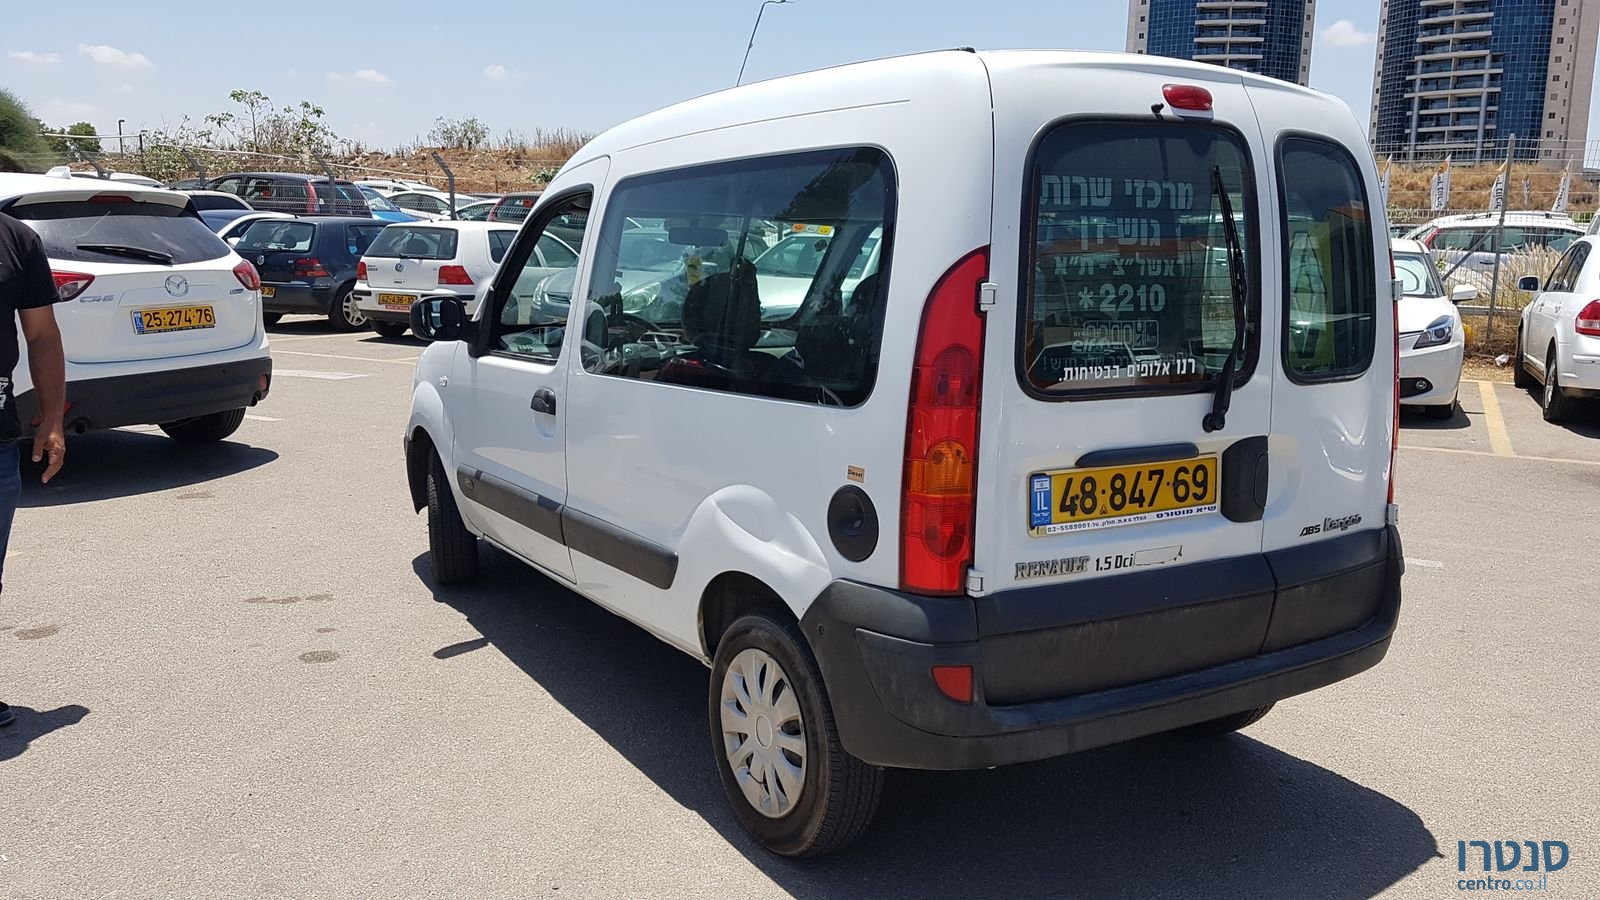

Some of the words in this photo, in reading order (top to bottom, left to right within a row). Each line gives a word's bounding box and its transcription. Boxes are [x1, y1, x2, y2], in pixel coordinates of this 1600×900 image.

[1040, 175, 1112, 207] שרות
[1124, 179, 1193, 209] מרכזי
[1080, 215, 1106, 250] דן
[1117, 217, 1161, 247] גוש
[1059, 365, 1120, 381] בבטיחות.
[1127, 360, 1170, 377] אלופים
[1176, 358, 1196, 375] רנו
[1036, 492, 1048, 510] IL
[1196, 505, 1217, 513] שיא
[1156, 508, 1193, 518] מוטורס
[1300, 524, 1321, 536] ABS
[1015, 556, 1090, 580] RENAULT
[1095, 555, 1112, 571] 1.5
[1114, 554, 1134, 569] Dci
